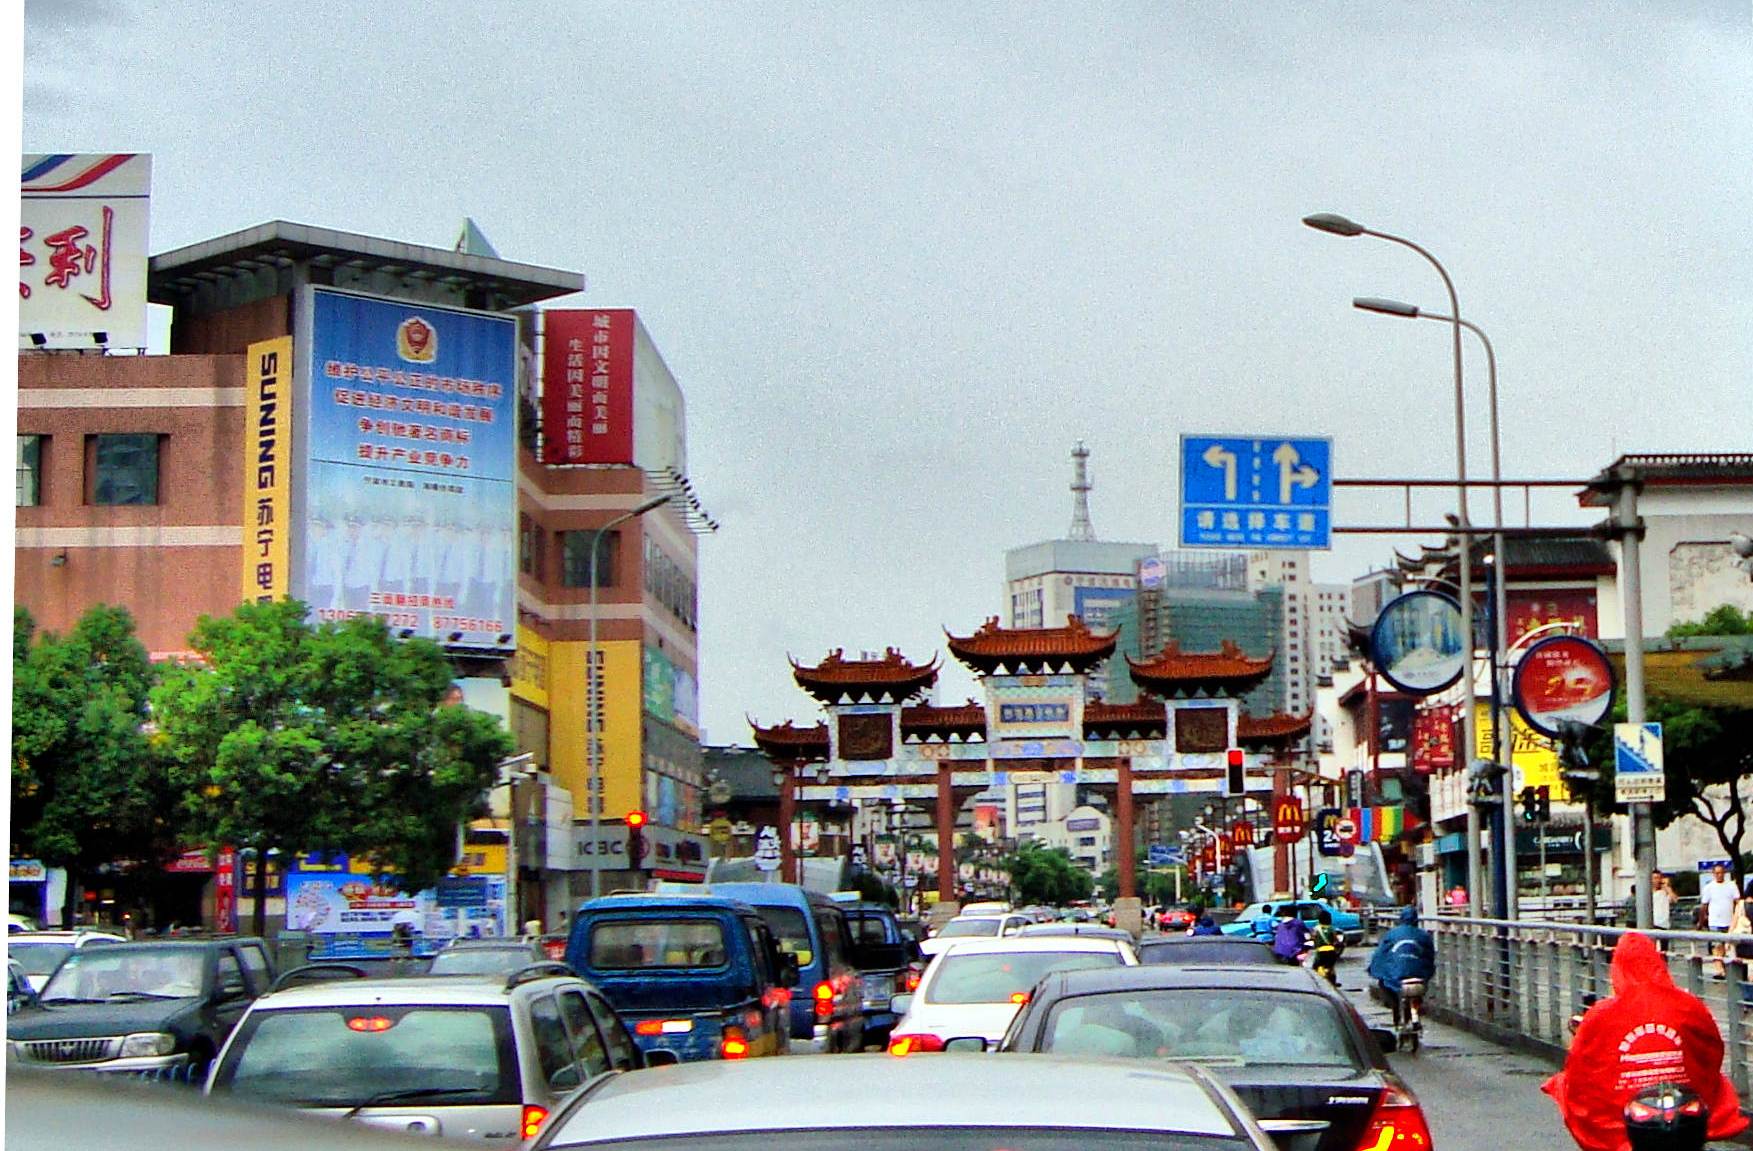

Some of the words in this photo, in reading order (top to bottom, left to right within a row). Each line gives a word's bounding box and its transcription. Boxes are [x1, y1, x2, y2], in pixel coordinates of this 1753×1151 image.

[21, 206, 112, 310] 利
[258, 352, 277, 489] SUNING
[567, 339, 584, 458] 生活因美丽而精彩
[591, 315, 610, 434] 城市因文明而美丽
[358, 443, 469, 469] 提升产业竞争力
[256, 498, 275, 603] 苏宁电
[1197, 511, 1315, 531] 请选择车道
